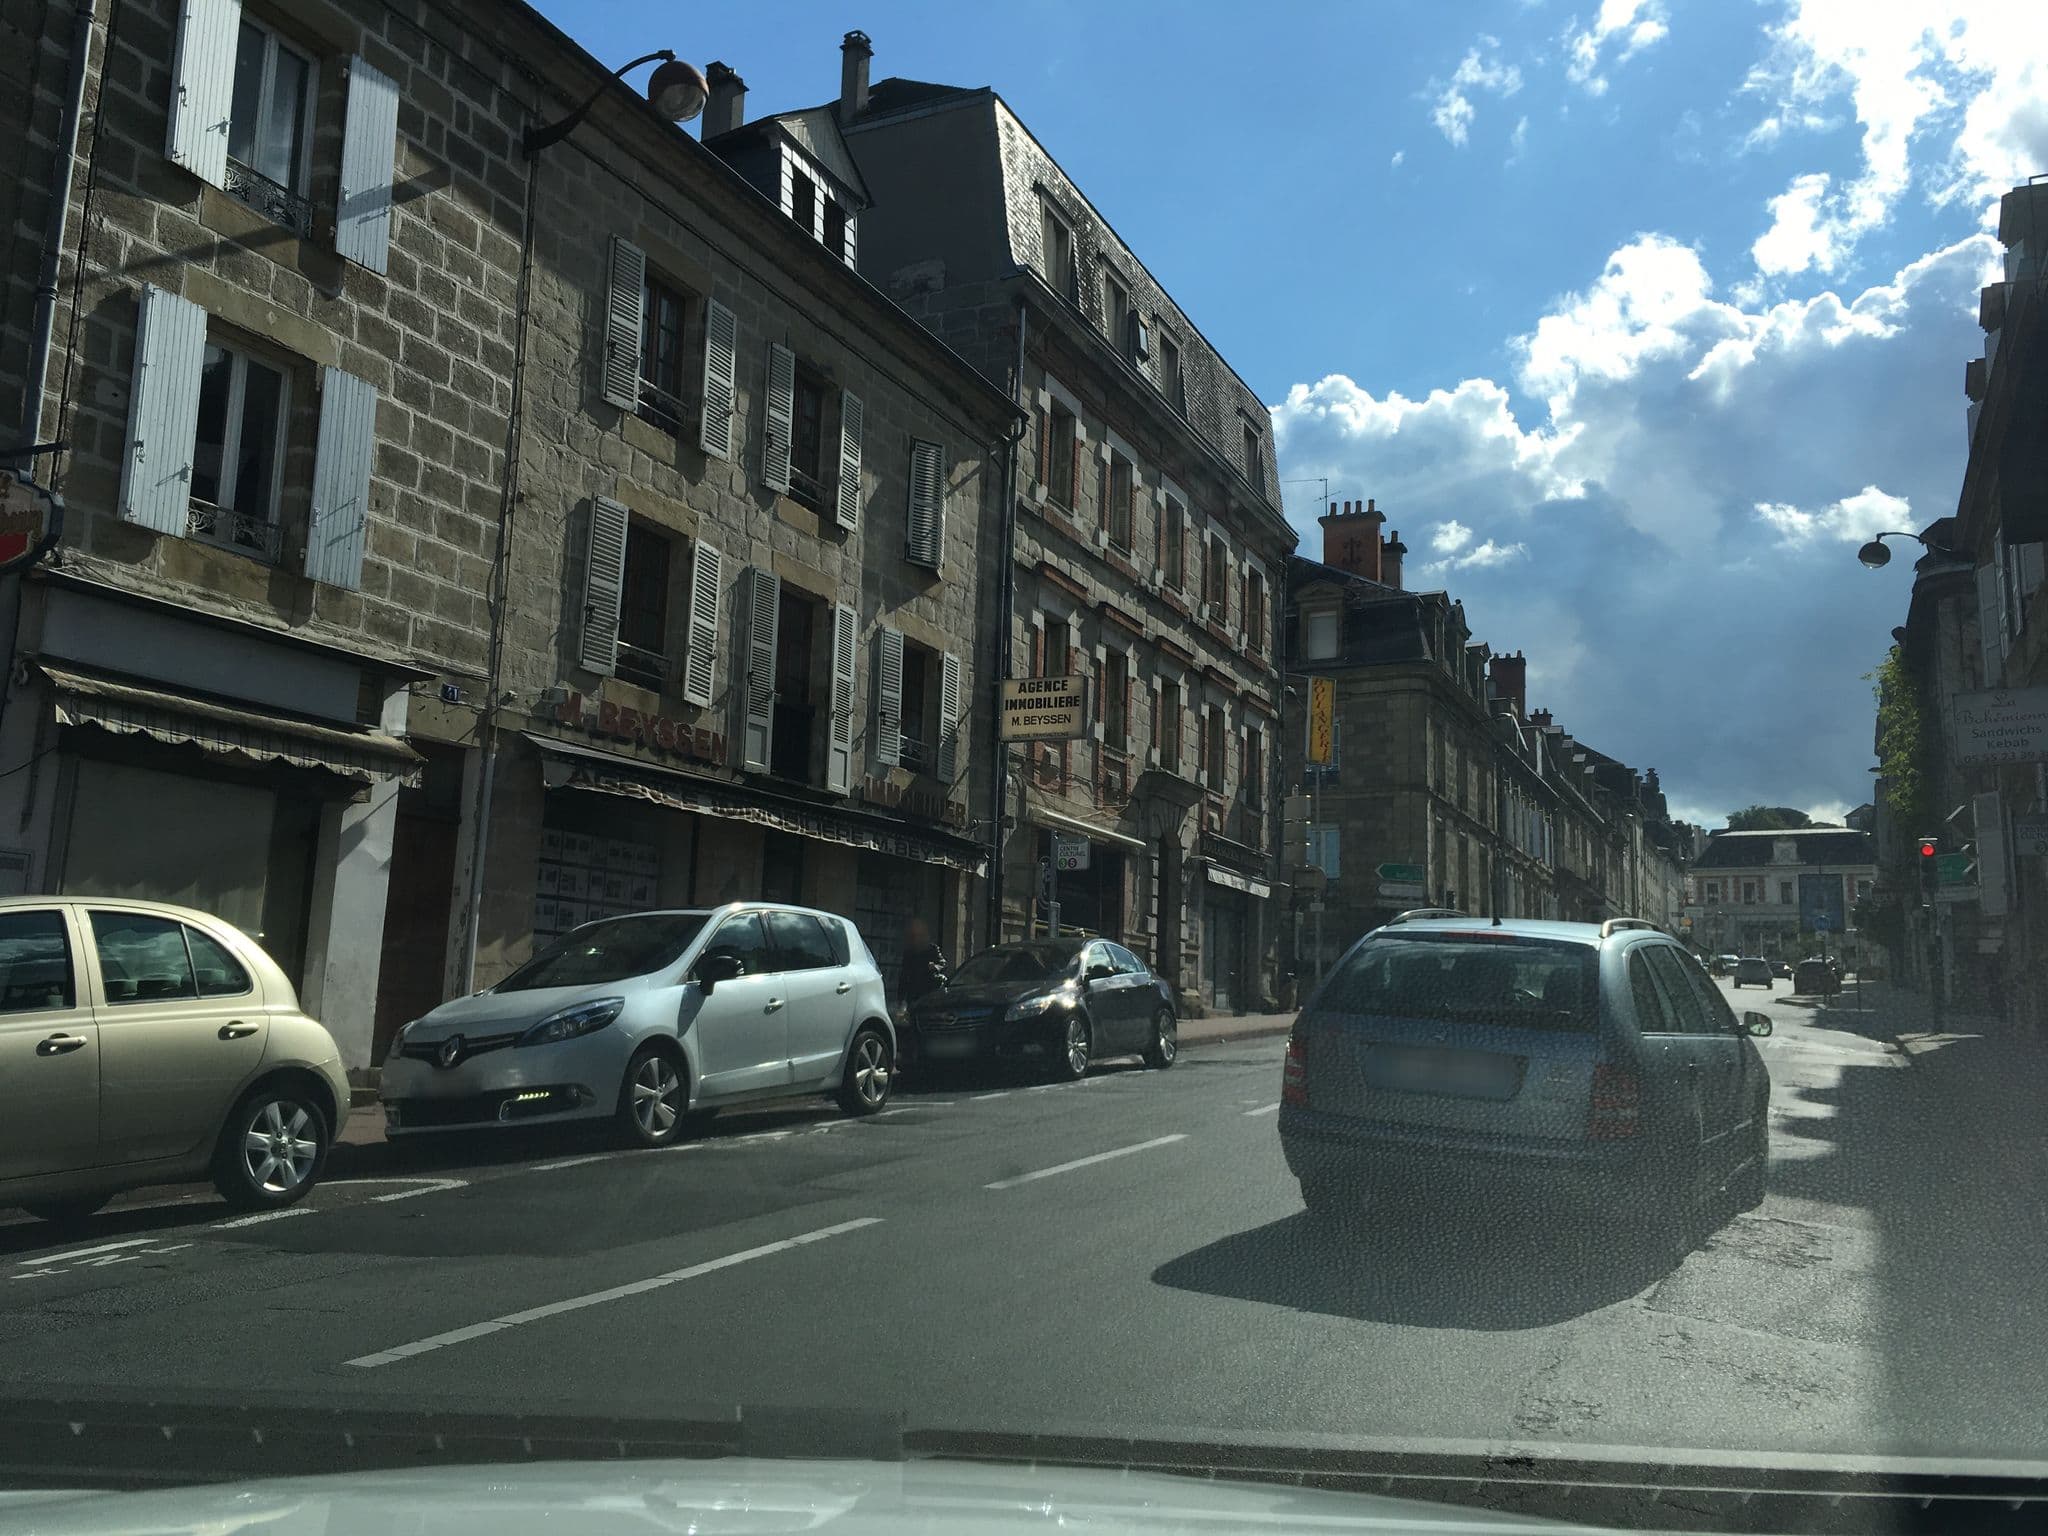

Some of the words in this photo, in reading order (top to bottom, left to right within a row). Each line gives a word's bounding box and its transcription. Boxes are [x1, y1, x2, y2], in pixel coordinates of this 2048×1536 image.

[1018, 680, 1068, 693] AGENCE
[1005, 696, 1080, 710] IMMOBILIERE
[1011, 717, 1021, 726] M.
[1023, 714, 1071, 725] BEYSSEN
[599, 699, 728, 765] BEYSSEN
[1972, 725, 2042, 738] Sandwichs
[1987, 738, 2029, 750] Kebab
